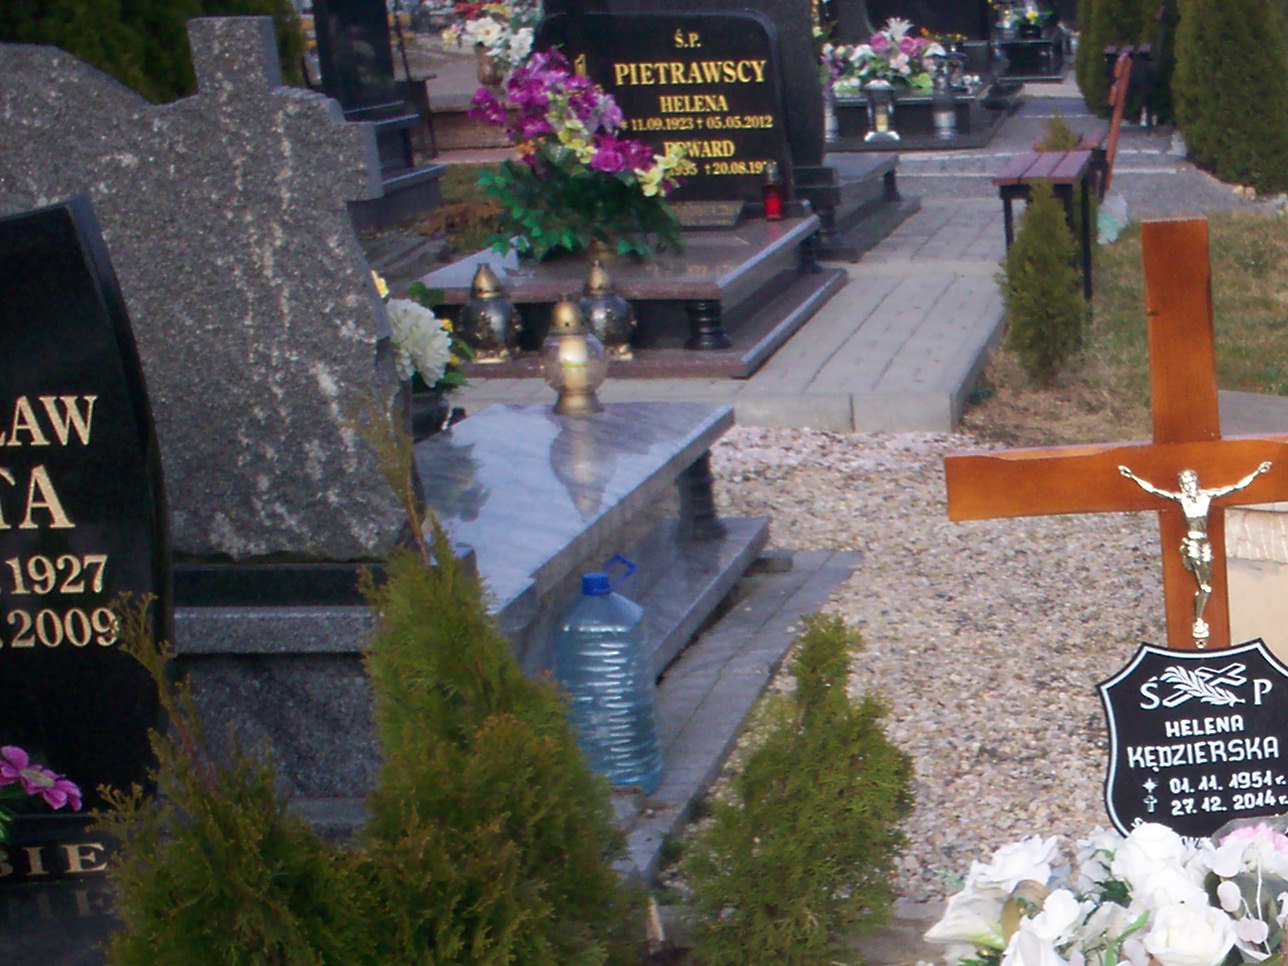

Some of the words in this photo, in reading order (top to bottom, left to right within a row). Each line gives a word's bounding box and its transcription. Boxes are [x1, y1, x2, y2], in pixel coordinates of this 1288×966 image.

[613, 60, 767, 86] PIETRAWSCY
[659, 94, 729, 113] HELENA
[5, 553, 108, 595] 1927
[1164, 714, 1244, 738] HELENA
[1127, 736, 1280, 772] KĘDZIERSKA
